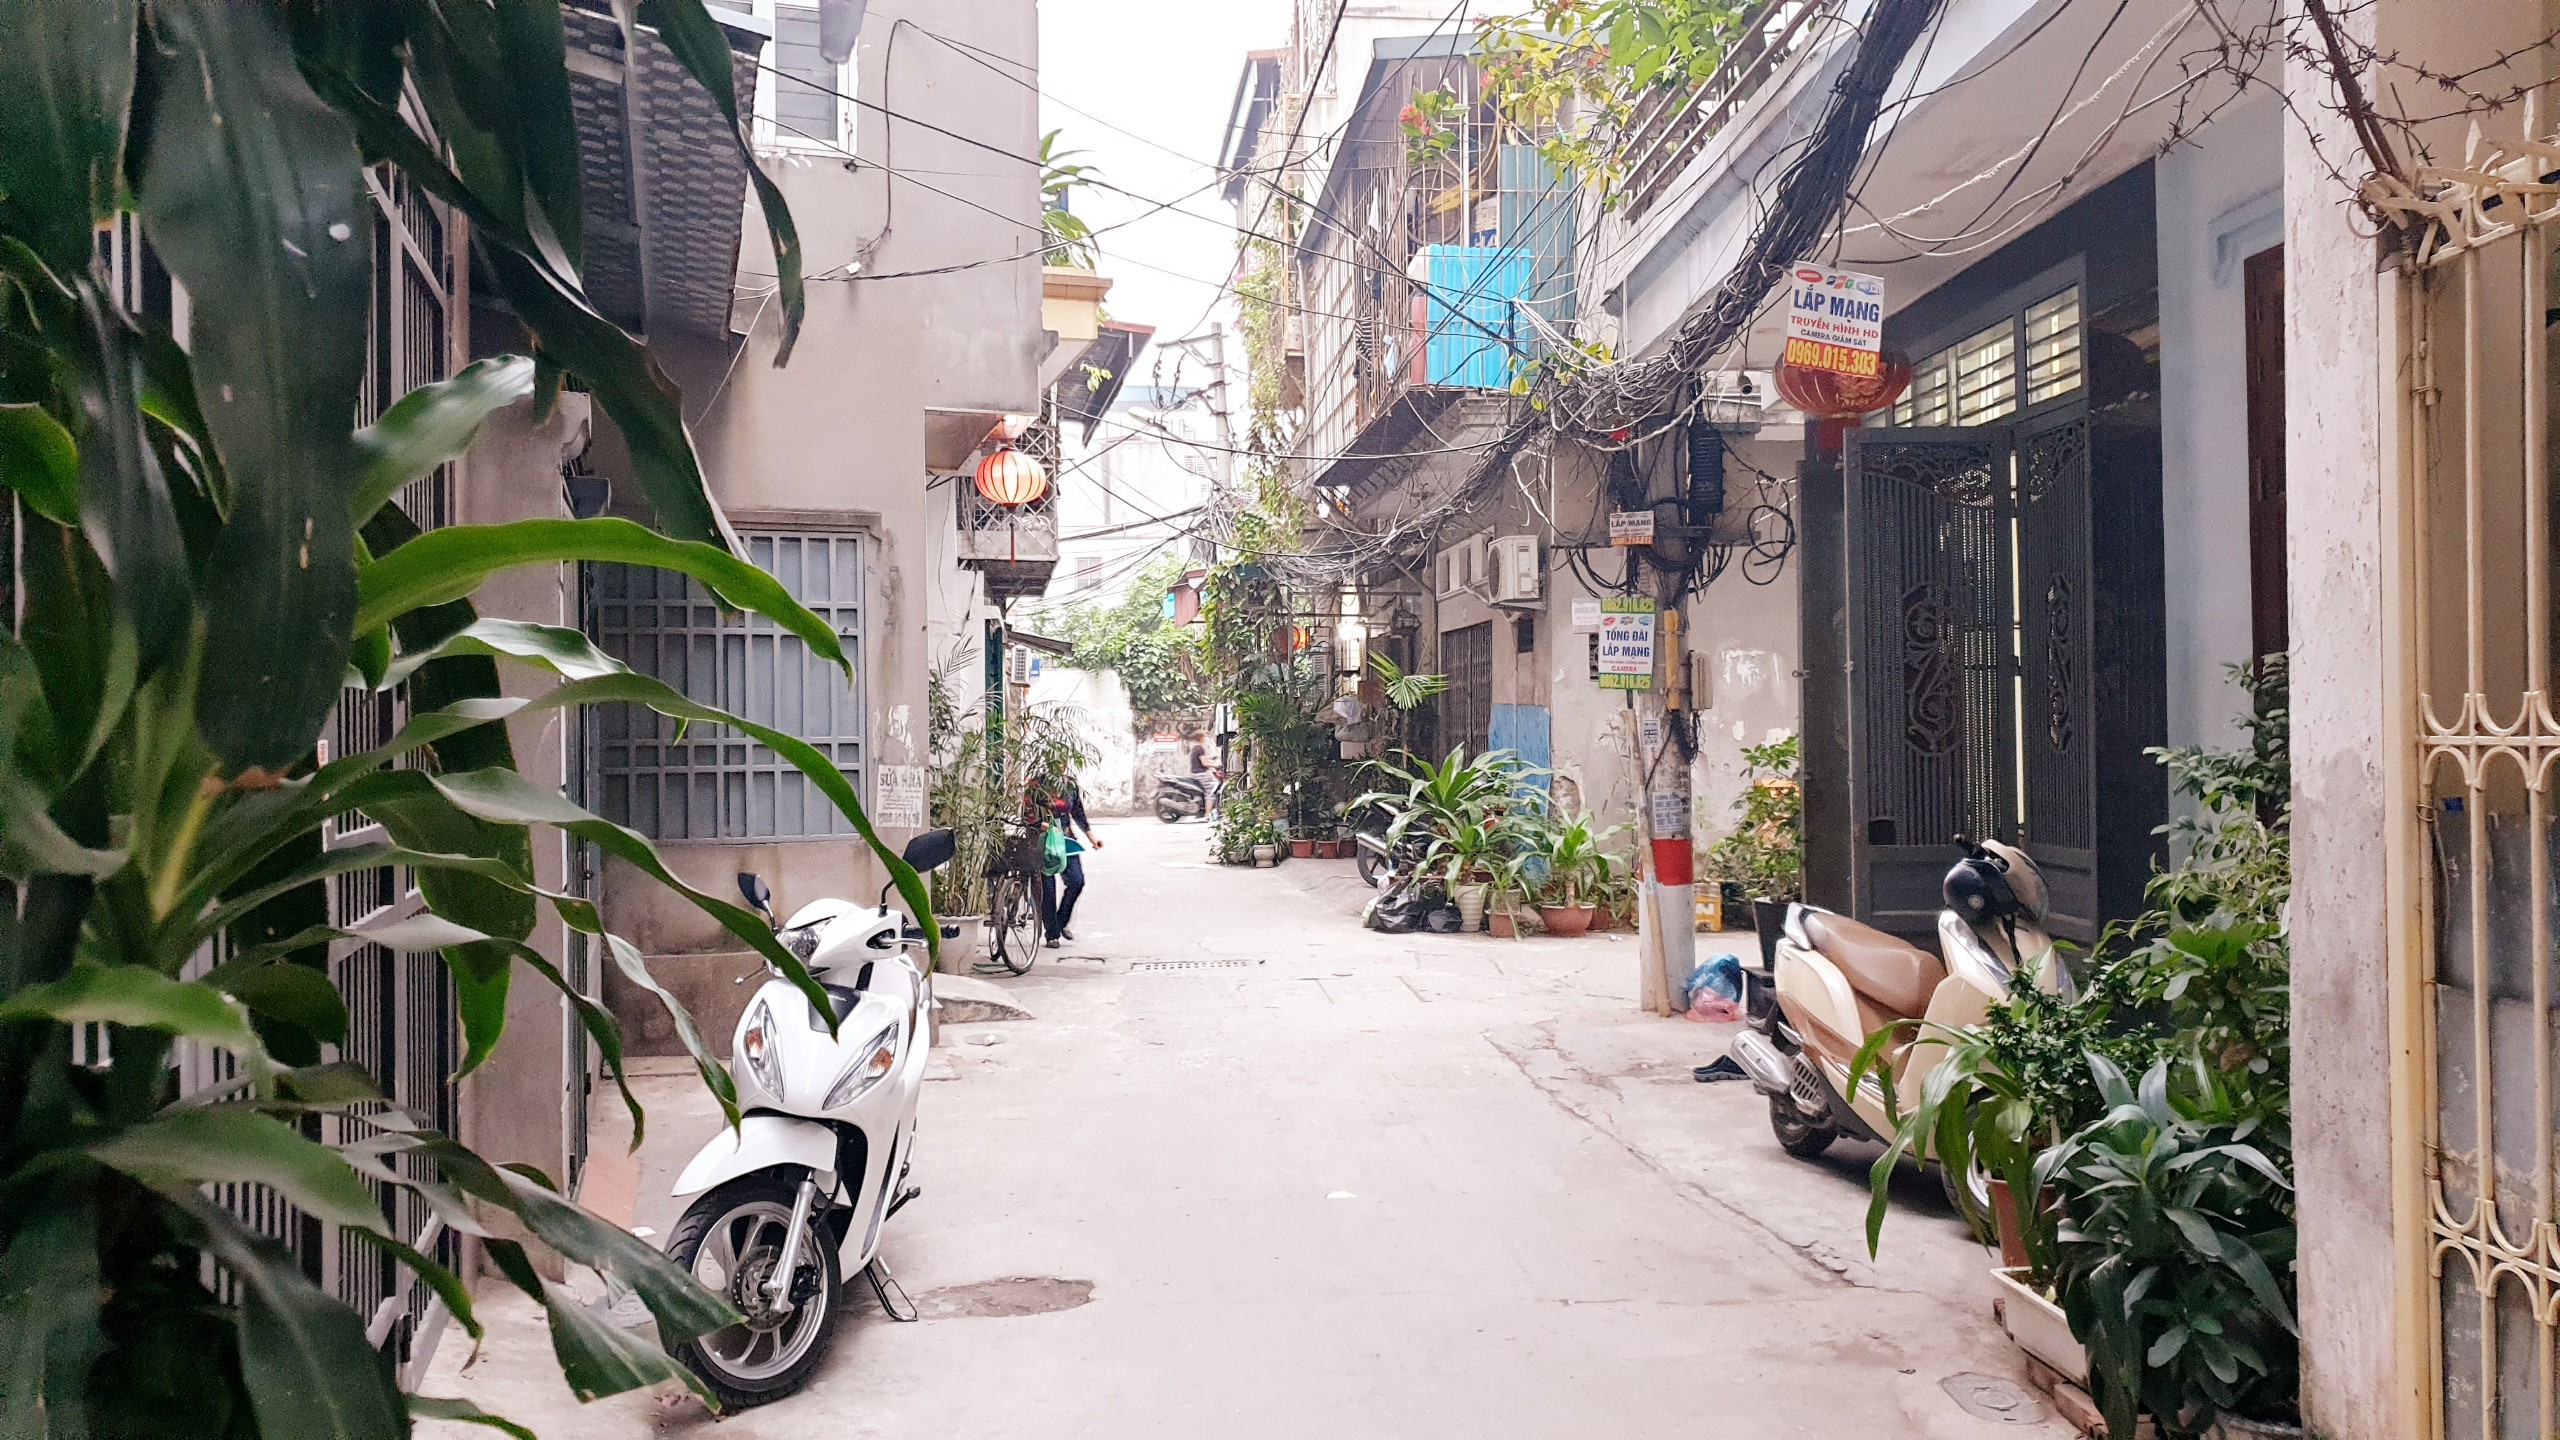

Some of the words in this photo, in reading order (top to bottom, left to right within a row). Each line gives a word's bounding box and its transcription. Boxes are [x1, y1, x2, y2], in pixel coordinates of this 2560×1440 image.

[1793, 284, 1825, 313] LẮP
[1829, 296, 1880, 323] MẠNG
[1800, 329, 1830, 341] CAMERA
[1831, 333, 1852, 345] GIÁM
[1853, 337, 1867, 347] SÁT
[1832, 322, 1859, 336] HÌNH
[1862, 329, 1878, 339] HD
[1786, 339, 1877, 376] 0969.015.303
[1632, 629, 1648, 642] ĐÀI
[1602, 642, 1619, 656] LẮP
[1622, 646, 1650, 660] MẠNG
